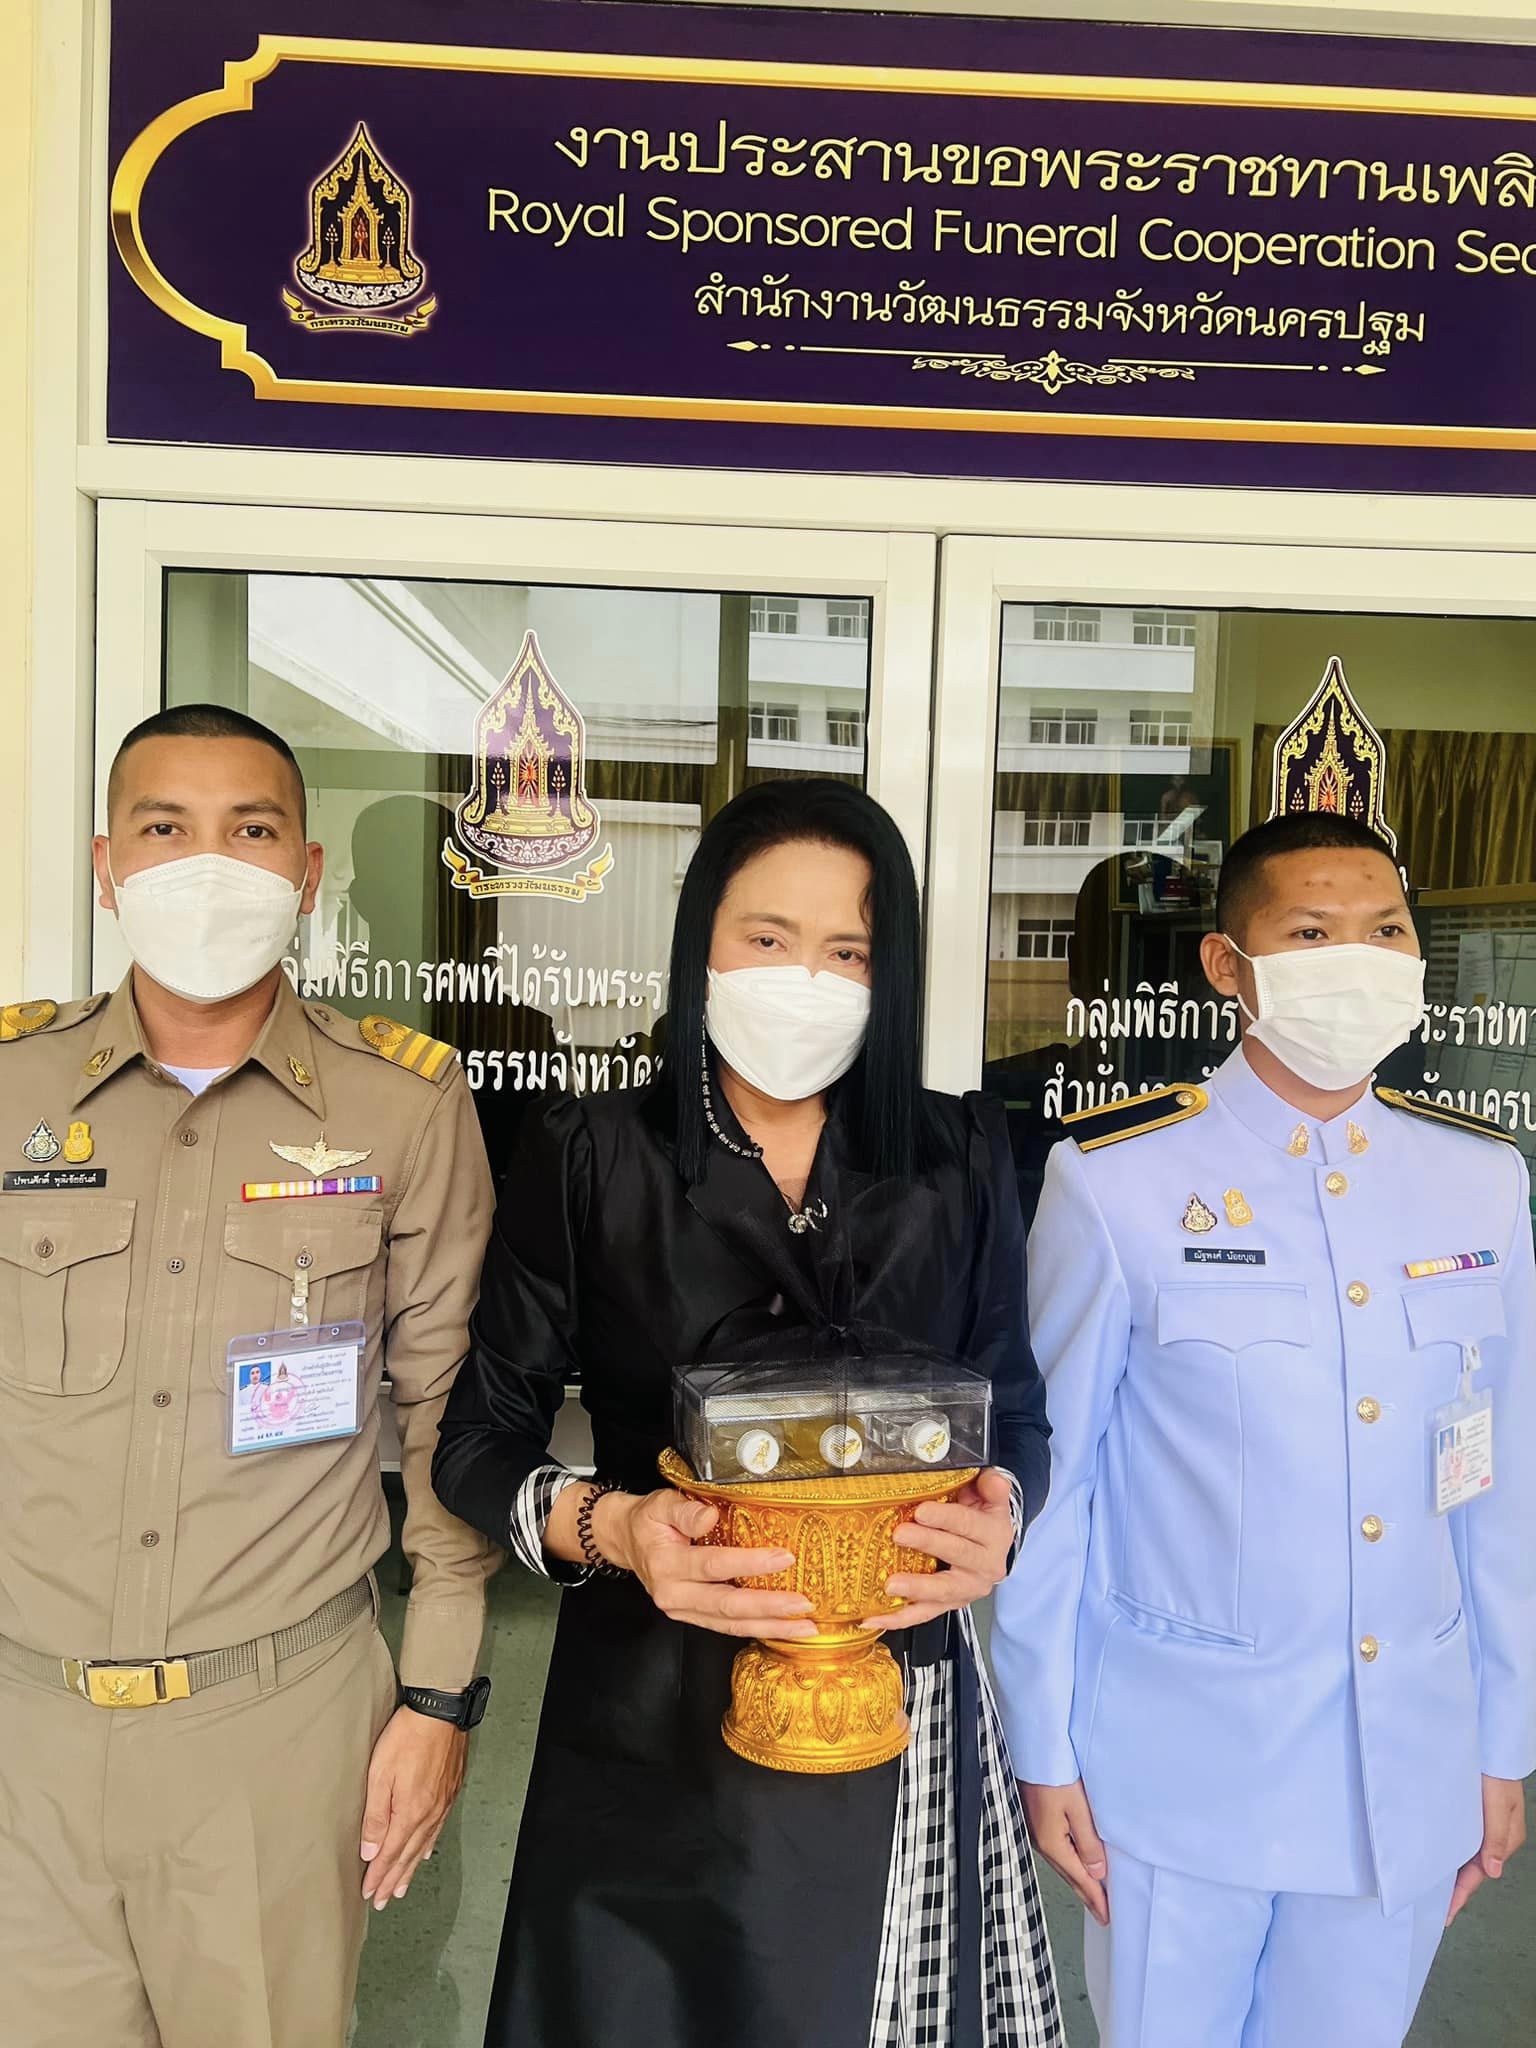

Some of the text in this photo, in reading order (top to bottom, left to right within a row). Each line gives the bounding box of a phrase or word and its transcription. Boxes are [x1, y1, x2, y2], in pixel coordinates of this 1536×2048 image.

[554, 119, 1536, 209] งานประสานขอพระราชทานเพลิ
[487, 187, 626, 248] Royal
[645, 195, 913, 254] Sponsored
[934, 207, 1118, 260] Funeral
[1138, 217, 1436, 275] Cooperation
[694, 271, 1426, 356] สำนักงานวัฒนธรรมจังหวัดนครปฐม
[474, 879, 581, 897] กระทรวงวัฒนธรรม
[1066, 978, 1239, 1055] กลุ่มพิธีการ
